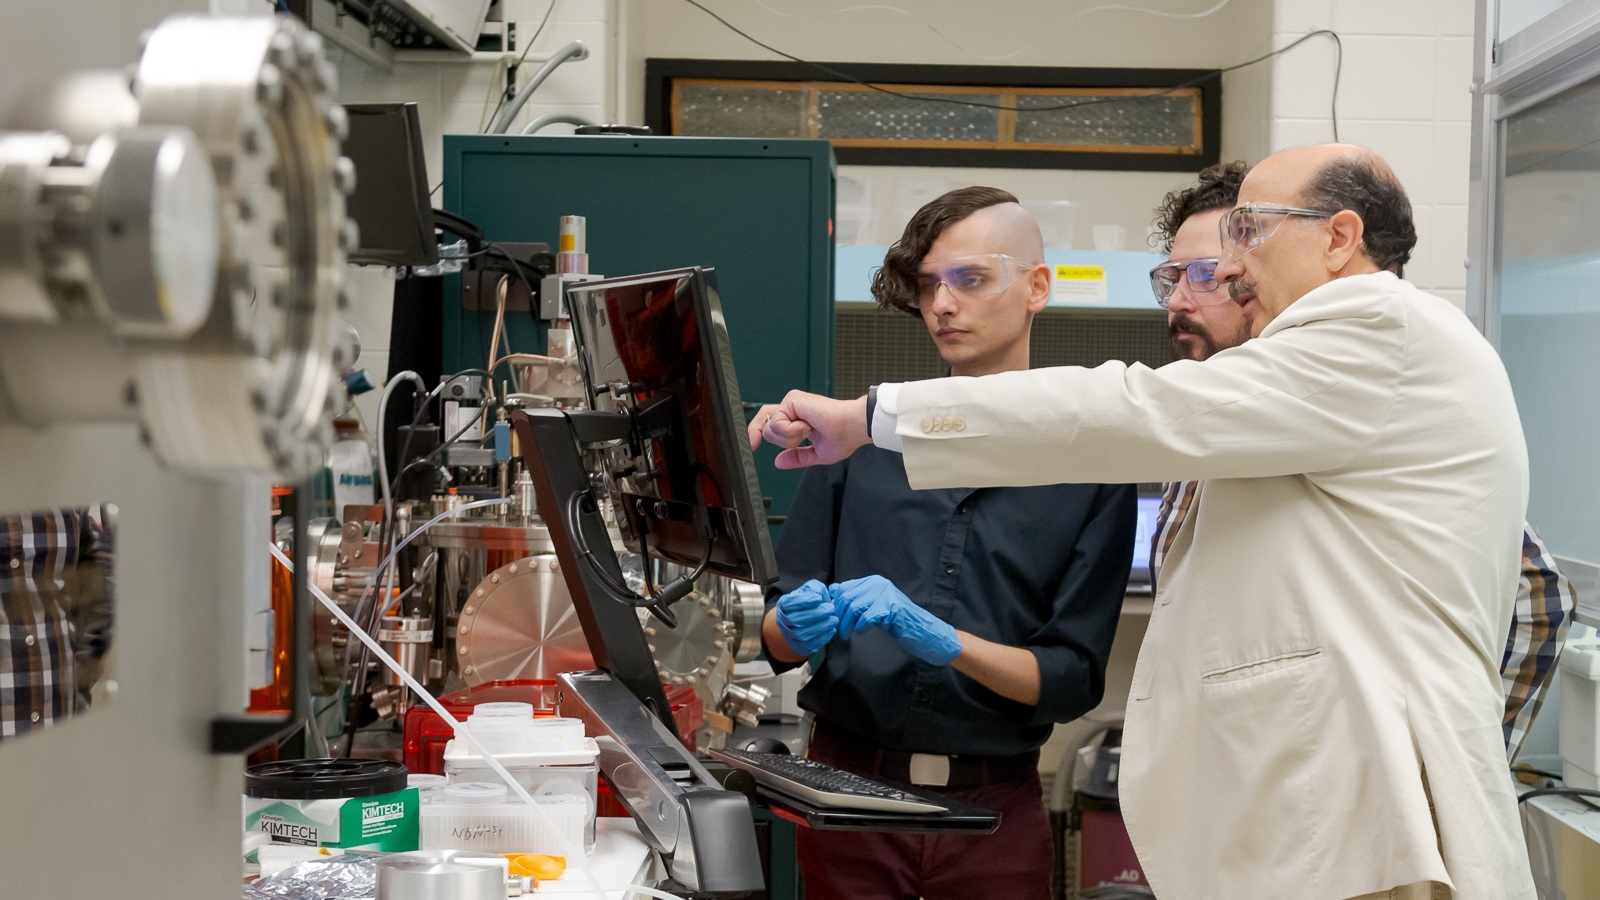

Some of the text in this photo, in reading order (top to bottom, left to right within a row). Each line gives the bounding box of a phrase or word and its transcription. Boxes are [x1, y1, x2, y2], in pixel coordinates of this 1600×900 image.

[1066, 268, 1103, 277] CAUTION
[339, 473, 373, 487] Airgas
[362, 802, 404, 819] KIMTECH
[261, 821, 318, 840] KIMTECH
